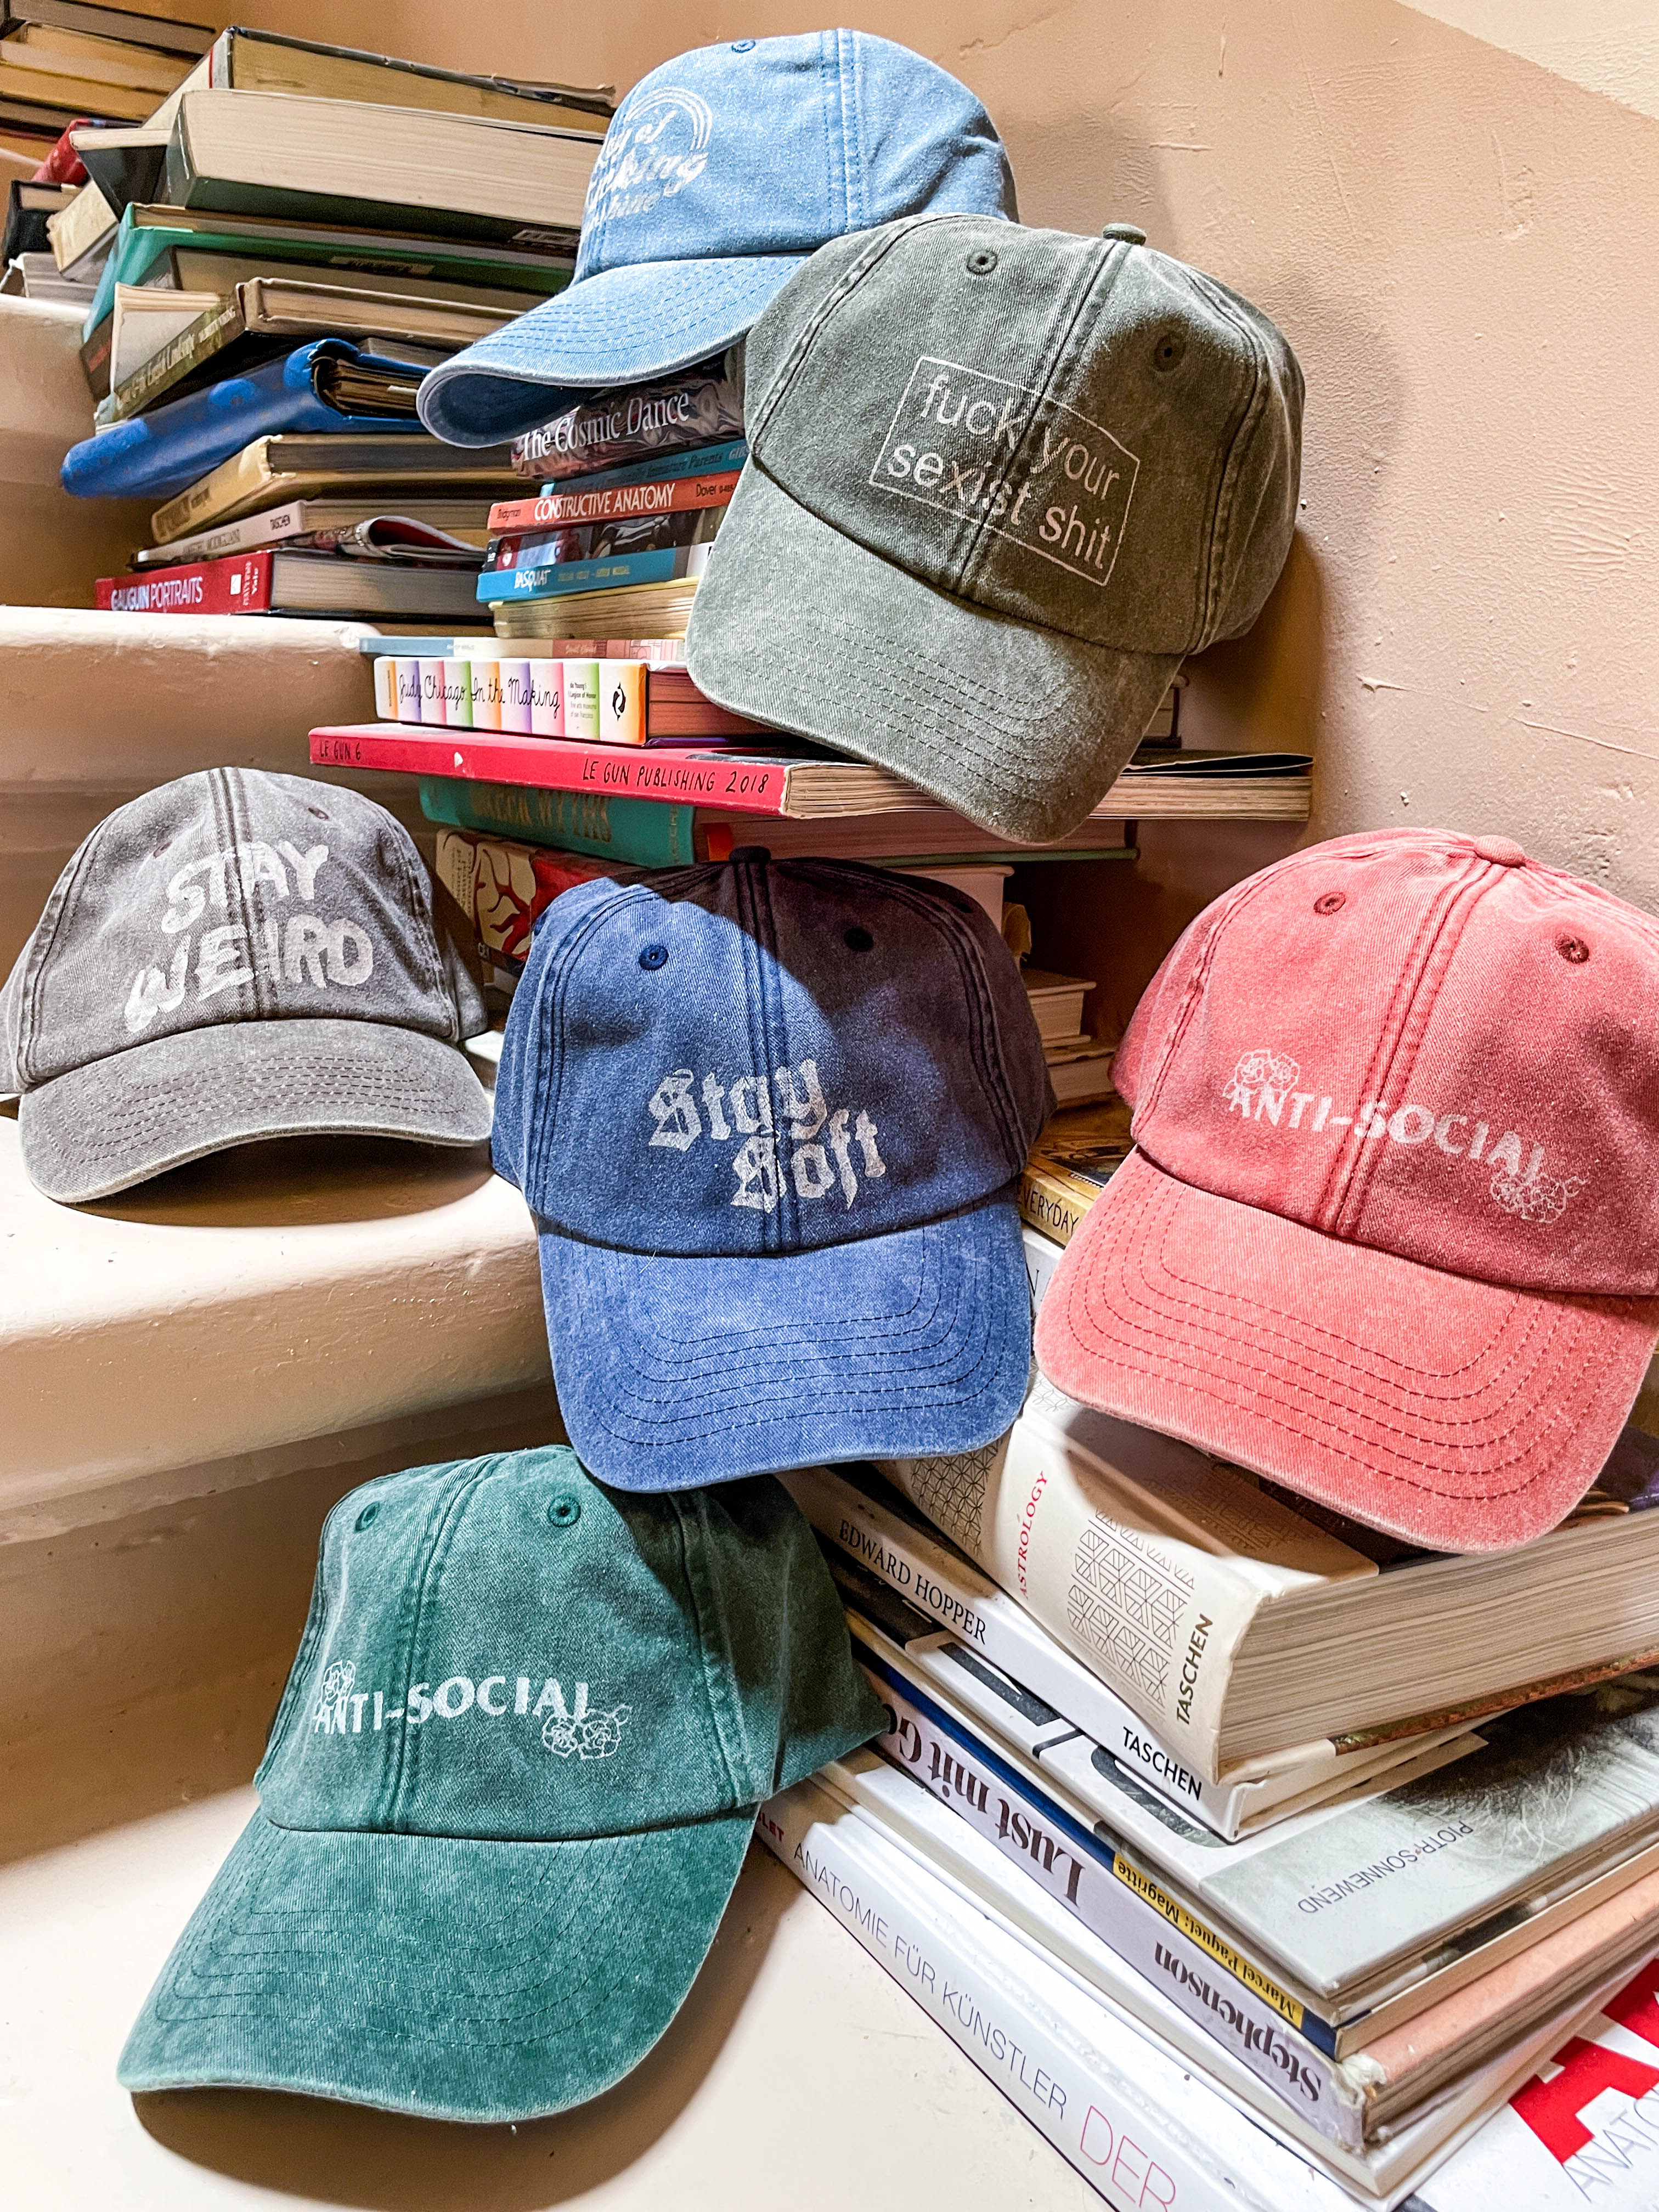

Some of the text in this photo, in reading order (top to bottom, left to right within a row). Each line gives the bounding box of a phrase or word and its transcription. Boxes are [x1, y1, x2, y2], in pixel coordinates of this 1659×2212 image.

[524, 392, 690, 461] The Cosmic Dance
[920, 374, 1119, 500] fuck your
[534, 494, 612, 521] CONSTRUCTIVE
[614, 483, 676, 515] ANATOMY
[696, 483, 716, 497] Dover
[887, 444, 1111, 569] sexist shit
[111, 577, 204, 611] GAUGUIN PORTRAITS
[399, 674, 422, 708] Judy
[488, 678, 506, 704] the
[508, 676, 560, 719] Making
[319, 741, 362, 760] LE GUN 6
[583, 759, 770, 795] LE GUN PUBLISHING 2018
[161, 840, 329, 935] STAY
[125, 914, 374, 1034] WEIRD
[648, 1058, 828, 1152] Stay
[1224, 1084, 1544, 1182] ANTI-SOCIAL
[730, 1109, 887, 1214] Soft
[839, 1519, 988, 1646] EDWARD HOPPER
[1018, 1470, 1048, 1599] ASTROLOGY
[314, 1676, 590, 1735] ANTI-SOCIAL
[1177, 1613, 1214, 1726] TASCHEN
[927, 1741, 991, 1818] mit
[1122, 1726, 1203, 1802] TASCHEN
[995, 1804, 1087, 1910] Lust
[1297, 1819, 1474, 1914] PIOTR SONNEWEND
[1118, 1859, 1298, 2021] Marcel Paquet: Magritte
[794, 1842, 889, 1948] ANATOMIE
[894, 1934, 936, 1994] FÜR
[942, 1980, 1067, 2120] KÜNSTLER
[1079, 2104, 1176, 2212] DER
[1154, 1940, 1322, 2103] Stephenson
